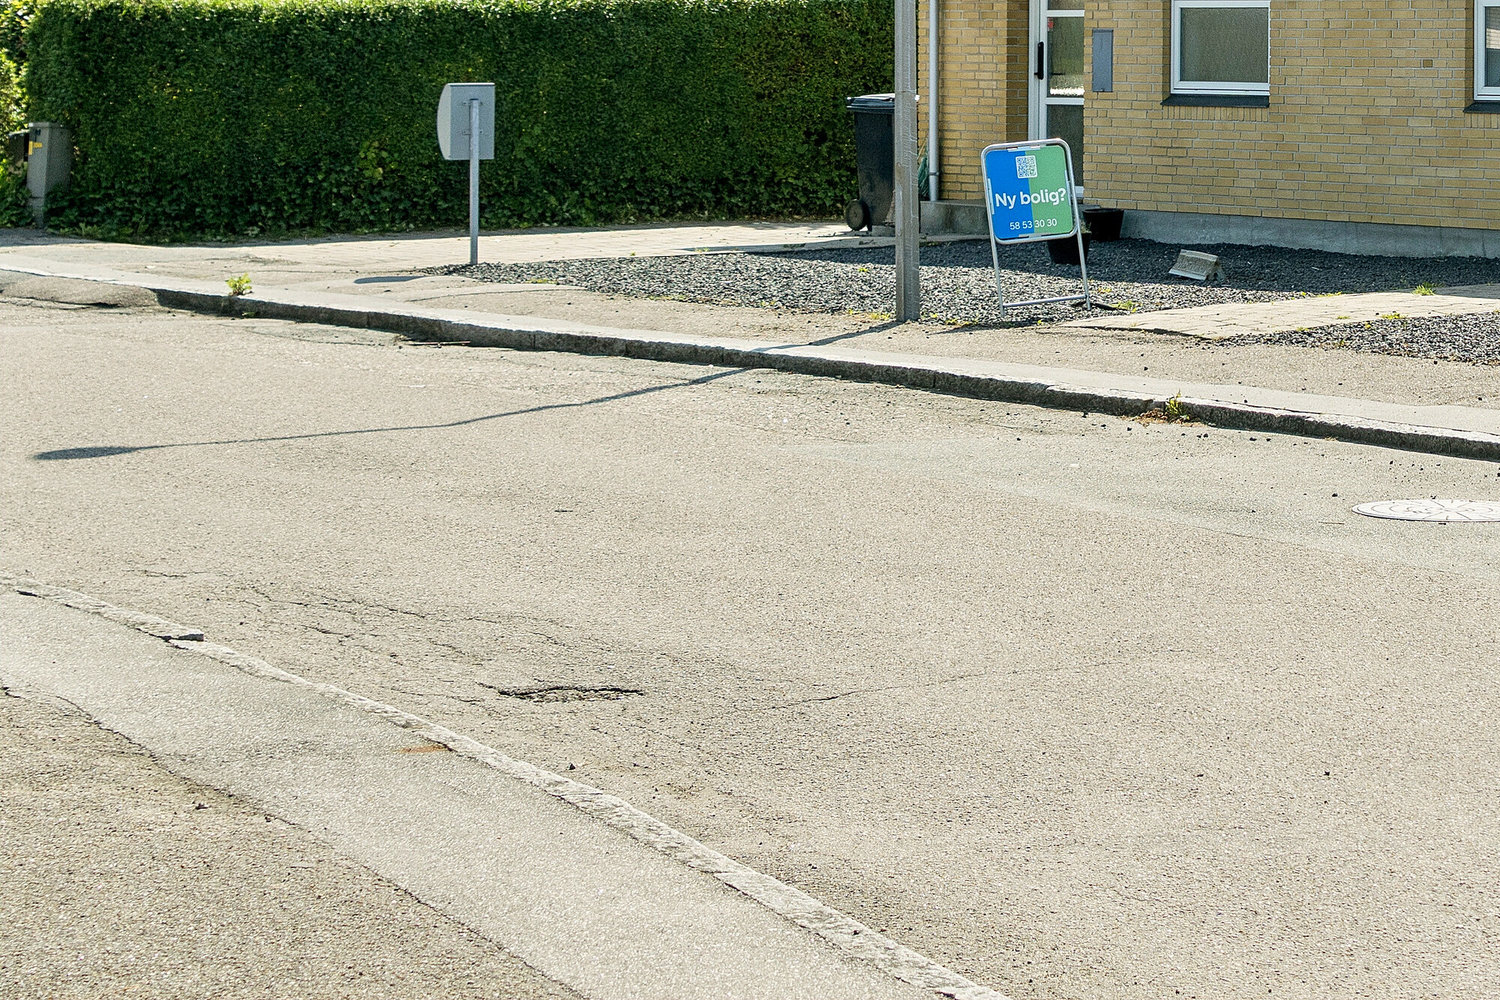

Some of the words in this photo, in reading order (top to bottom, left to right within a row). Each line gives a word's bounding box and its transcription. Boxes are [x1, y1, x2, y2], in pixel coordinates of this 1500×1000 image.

[995, 193, 1016, 209] Ny
[1020, 188, 1066, 206] bolig?
[1009, 221, 1020, 230] 58
[1022, 220, 1033, 229] 53
[1034, 219, 1045, 228] 30
[1046, 218, 1057, 227] 30
